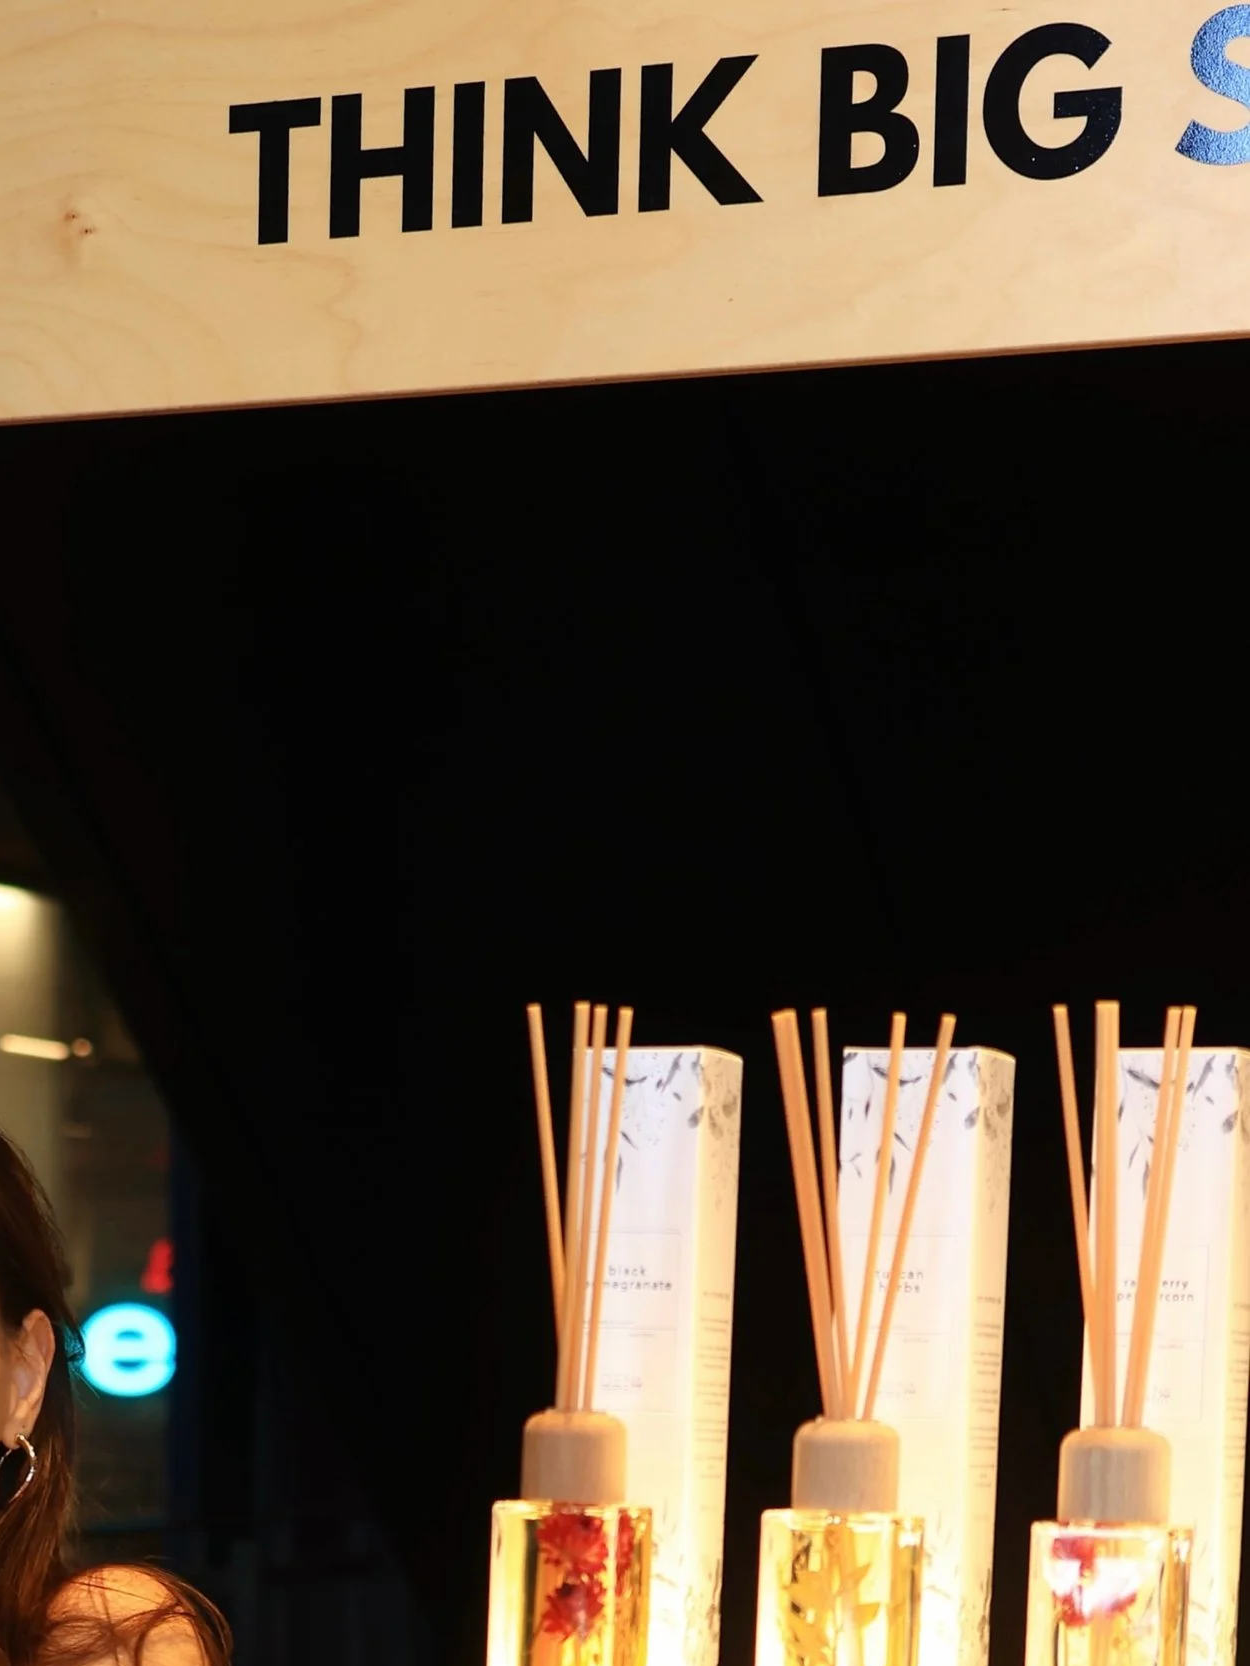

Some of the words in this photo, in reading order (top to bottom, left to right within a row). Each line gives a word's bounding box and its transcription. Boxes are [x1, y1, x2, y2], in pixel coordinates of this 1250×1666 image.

[229, 54, 763, 245] THINK
[818, 23, 1123, 197] BIG
[1174, 3, 1250, 165] S
[608, 1265, 647, 1276] black
[876, 1270, 924, 1279] tucan
[879, 1281, 920, 1293] hrbs
[1124, 1279, 1189, 1290] raerry
[1117, 1292, 1194, 1303] percorn
